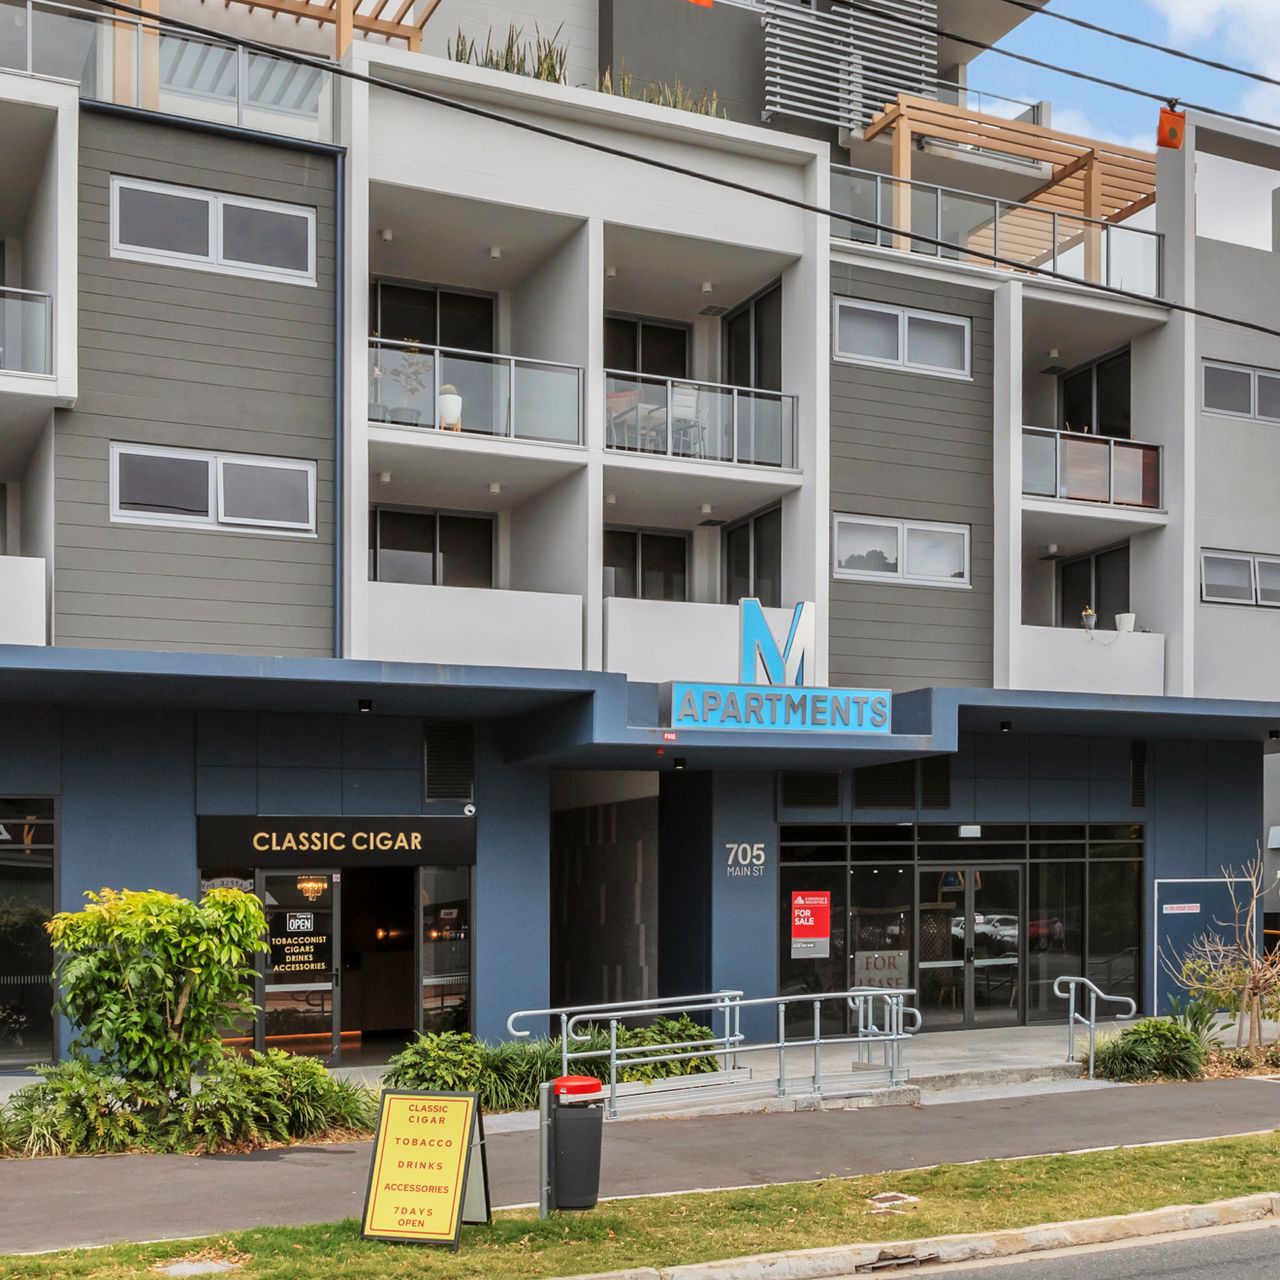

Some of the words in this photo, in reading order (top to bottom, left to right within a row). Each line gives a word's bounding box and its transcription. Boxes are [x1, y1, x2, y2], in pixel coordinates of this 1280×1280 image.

[676, 689, 888, 727] APARTMENTS
[252, 831, 346, 851] CLASSIC
[351, 831, 422, 851] CIGAR
[725, 843, 766, 865] 705
[727, 866, 751, 877] MAIN
[752, 865, 765, 876] ST
[794, 909, 811, 917] FOR
[289, 919, 311, 930] OPEN
[794, 917, 815, 925] SALE
[272, 936, 326, 945] TOBACCONIST
[284, 945, 314, 953] CIGARS
[286, 954, 313, 962] DRINKS
[865, 955, 897, 970] FOR
[273, 962, 326, 972] ACCESSORIES
[408, 1104, 448, 1113] CLASSIC
[408, 1115, 446, 1125] CIGAR
[395, 1137, 453, 1147] TOBACCO
[397, 1160, 443, 1170] DRINKS
[383, 1183, 449, 1194] ACCESSORIES
[397, 1218, 425, 1227] OPEN
